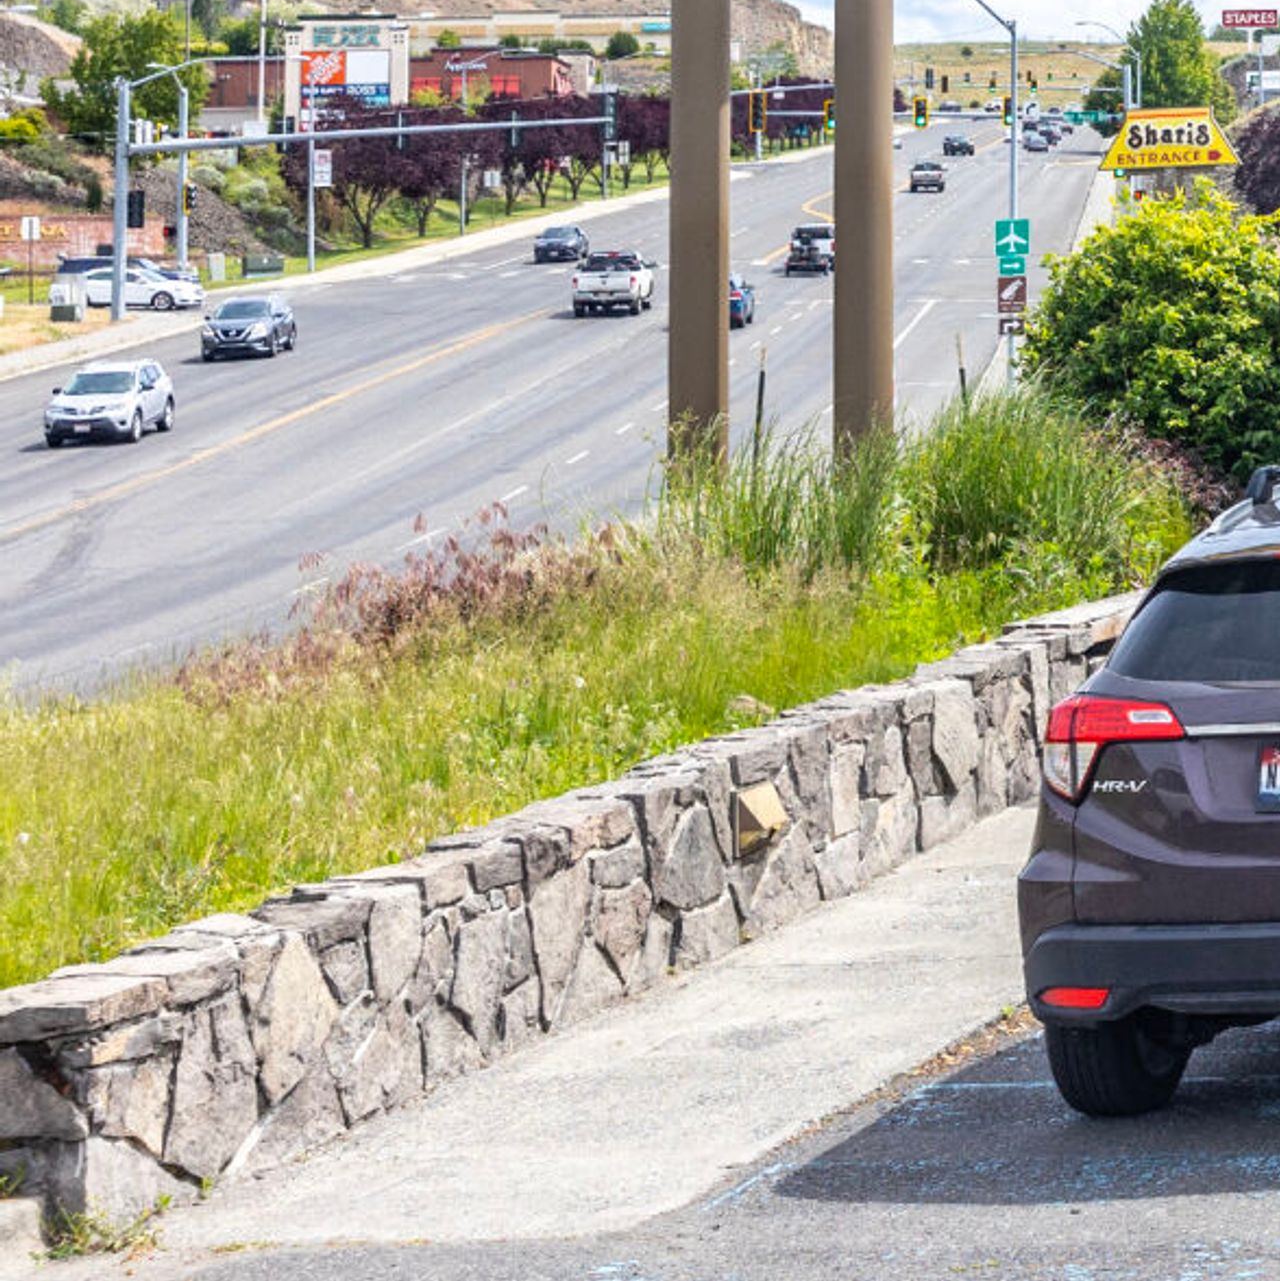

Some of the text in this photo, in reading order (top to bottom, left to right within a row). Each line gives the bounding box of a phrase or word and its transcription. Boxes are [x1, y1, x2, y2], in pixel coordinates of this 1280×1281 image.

[1224, 12, 1277, 25] STAPLES
[1126, 121, 1211, 150] Sharis
[1116, 150, 1201, 166] ENTRANCE
[1266, 762, 1278, 788] N
[1093, 780, 1147, 793] HR-V
